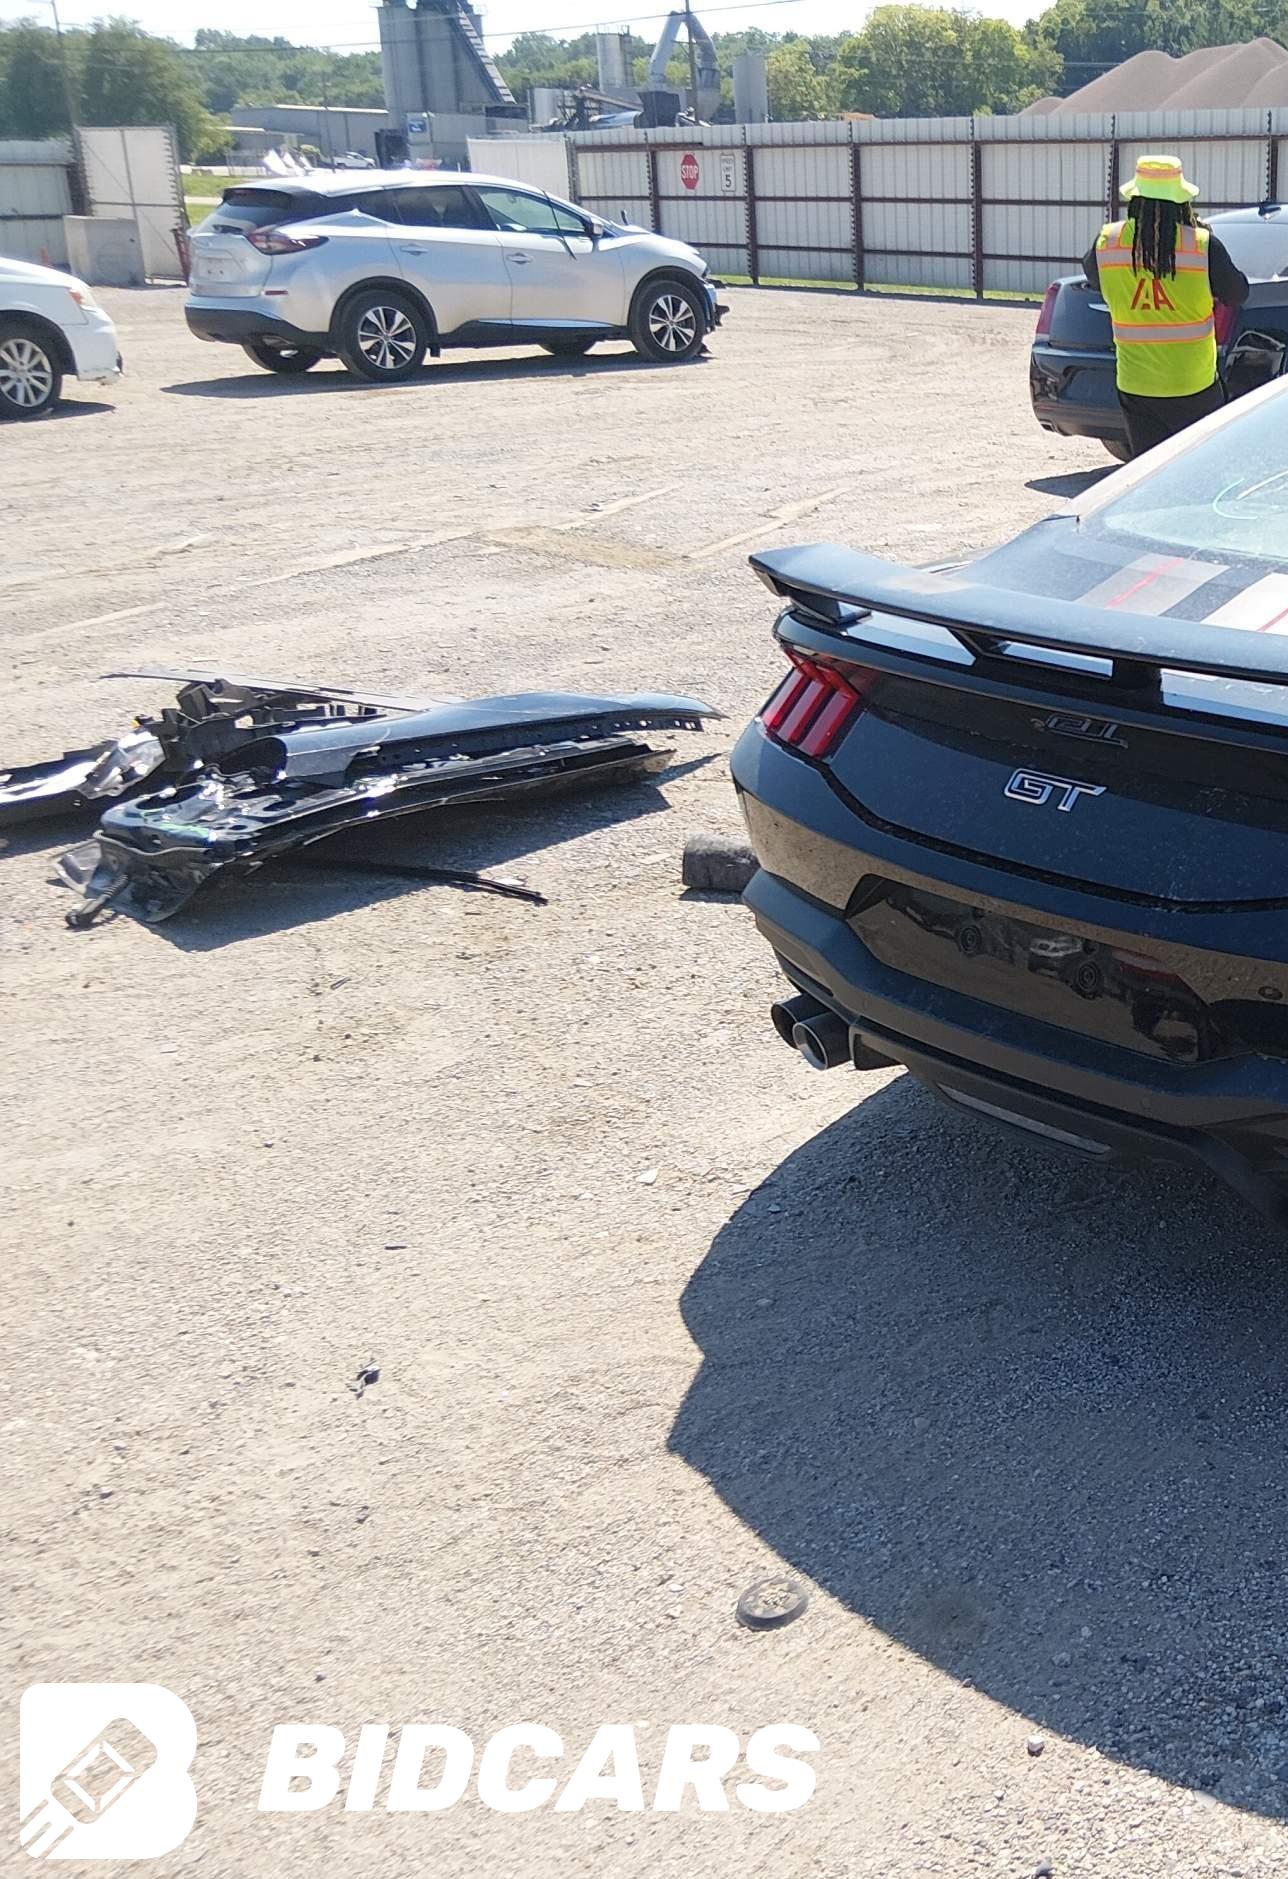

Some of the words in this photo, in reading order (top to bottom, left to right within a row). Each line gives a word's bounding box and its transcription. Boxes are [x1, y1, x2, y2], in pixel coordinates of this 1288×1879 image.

[681, 165, 699, 180] STOP
[725, 174, 732, 188] 5
[1003, 767, 1108, 812] GT
